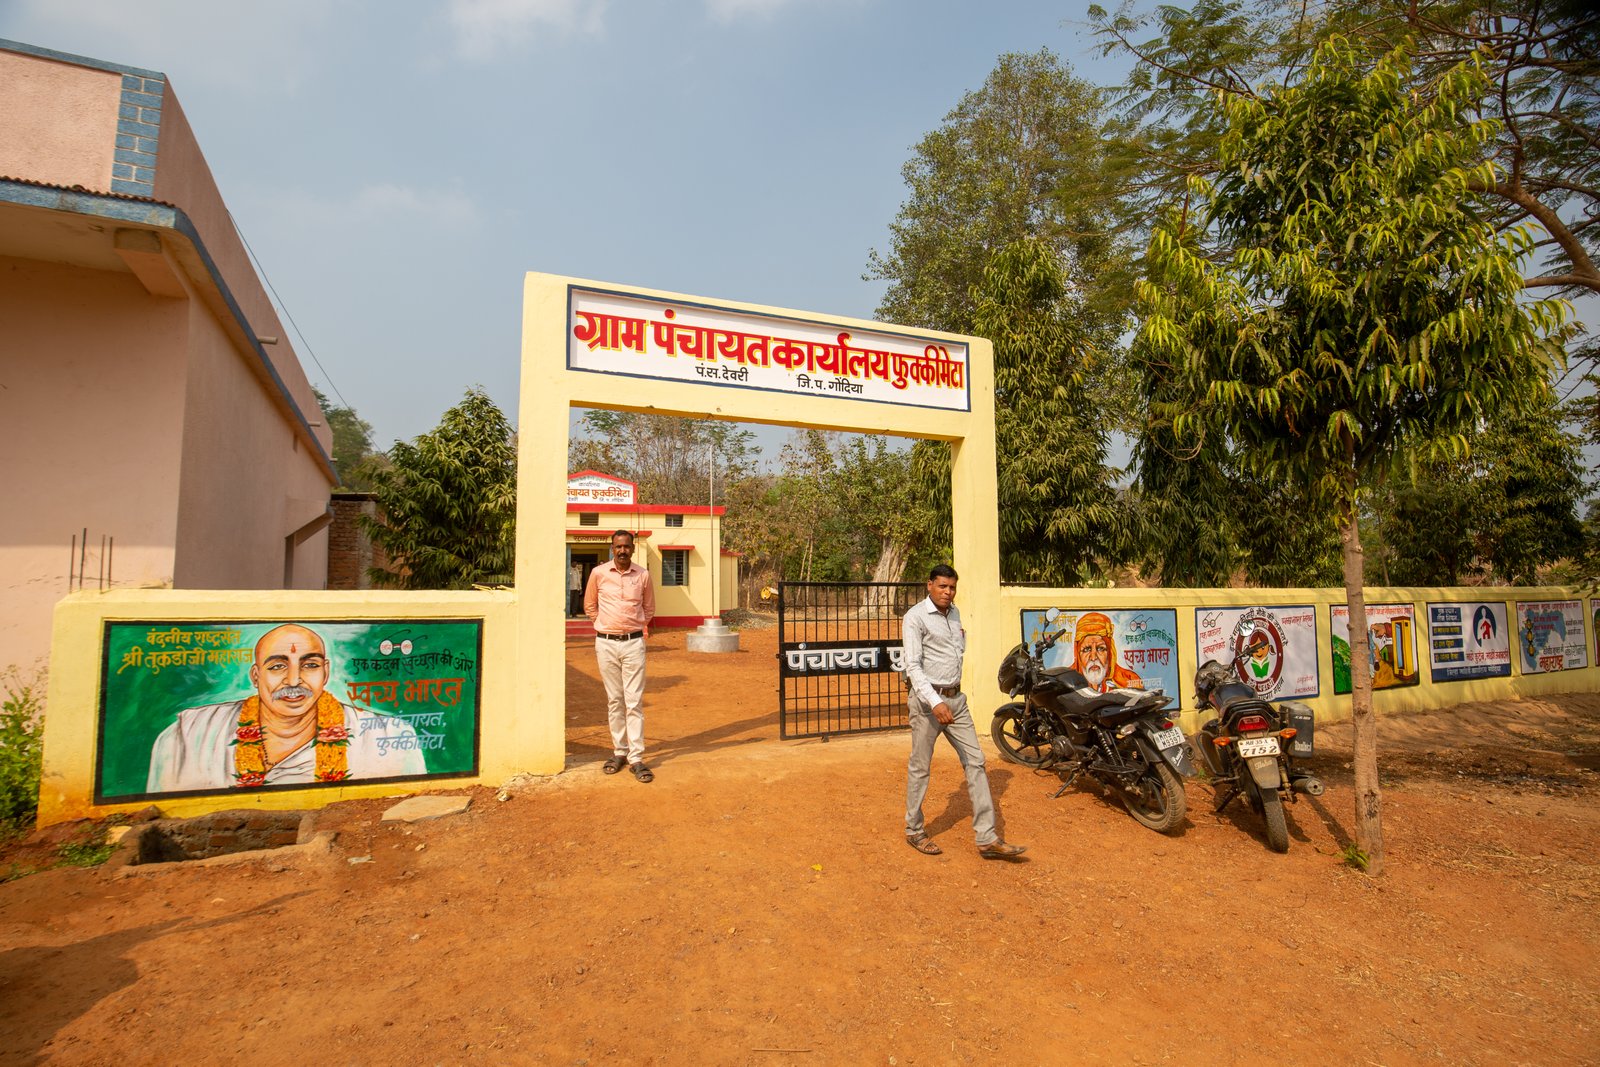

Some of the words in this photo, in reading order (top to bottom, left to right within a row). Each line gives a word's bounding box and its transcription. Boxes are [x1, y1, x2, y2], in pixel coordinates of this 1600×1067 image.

[573, 310, 647, 354] ग्राम
[650, 308, 772, 369] पंचायत
[772, 332, 891, 382] कार्यालय
[828, 377, 864, 395] गोंदिया
[146, 627, 193, 648] वंदनीय
[194, 626, 243, 647] राष्ट्रसंत
[116, 645, 144, 675] श्री
[144, 645, 208, 675] तुकडोजी
[207, 647, 254, 668] महाराज
[352, 657, 369, 675] एक
[370, 657, 400, 676] कदम
[438, 648, 453, 667] की
[453, 652, 474, 683] ओर
[786, 642, 880, 672] पंचायत
[1147, 648, 1171, 666] भारत
[403, 678, 466, 707] भारत
[359, 715, 392, 737] ग्राम
